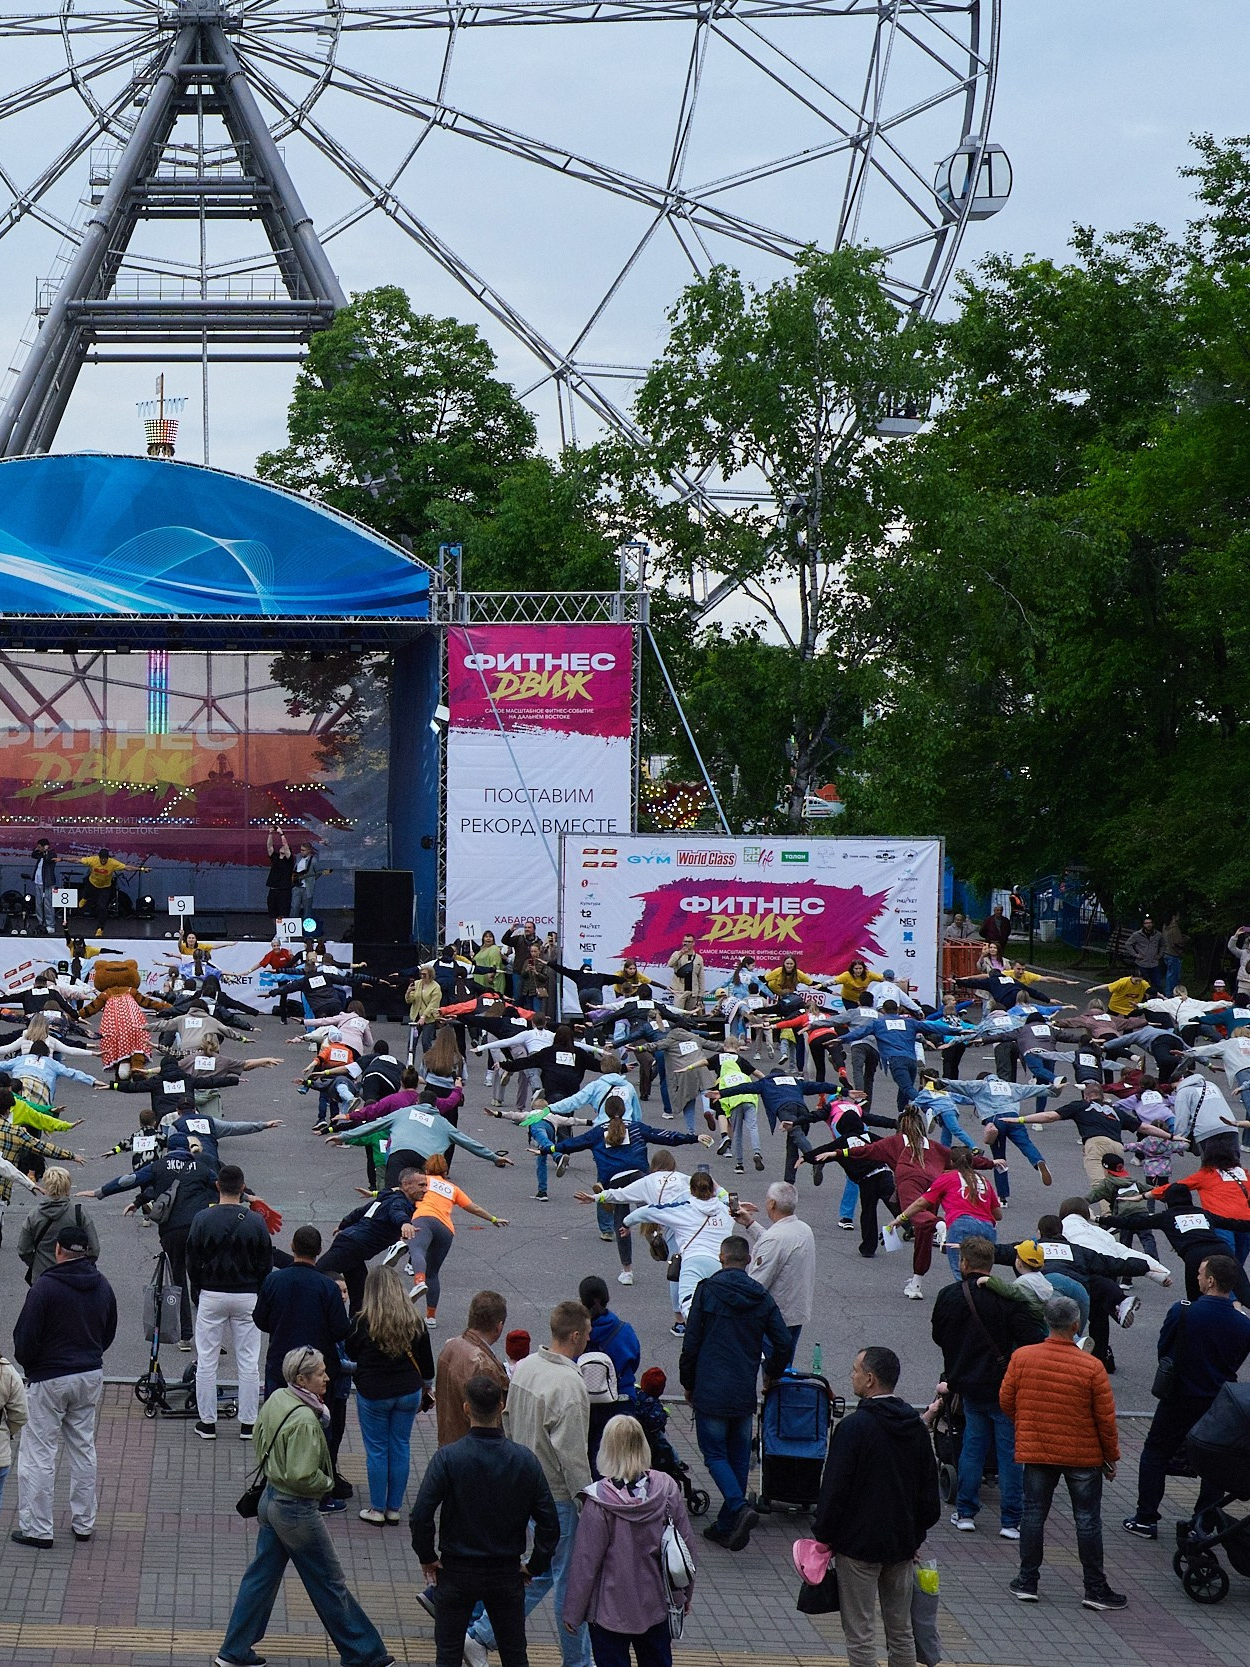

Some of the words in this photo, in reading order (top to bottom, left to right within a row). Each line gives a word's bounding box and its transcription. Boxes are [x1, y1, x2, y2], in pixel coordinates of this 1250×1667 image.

[464, 653, 616, 671] ФИТНЕС
[481, 669, 596, 703] ДВИЖ
[5, 748, 202, 808] ДВИЖ
[484, 788, 594, 803] ПОСТАВИМ
[68, 827, 113, 835] ДАЛЬНЕМ
[116, 827, 159, 835] ВОСТОКЕ
[461, 818, 536, 836] РЕКОРД
[542, 819, 617, 833] ВМЕСТЕ
[627, 856, 670, 864] GYM
[678, 852, 706, 865] World
[708, 853, 735, 866] Class
[61, 893, 69, 904] 8
[177, 900, 185, 912] 9
[680, 895, 825, 915] ФИТНЕС
[580, 909, 592, 918] t2
[494, 916, 554, 924] ХАБАРОВСК
[282, 922, 296, 933] 10
[466, 924, 474, 936] 11
[698, 913, 805, 944] ДВИЖ
[904, 949, 916, 957] t2
[432, 1182, 452, 1195] 260
[1181, 1219, 1201, 1228] 219
